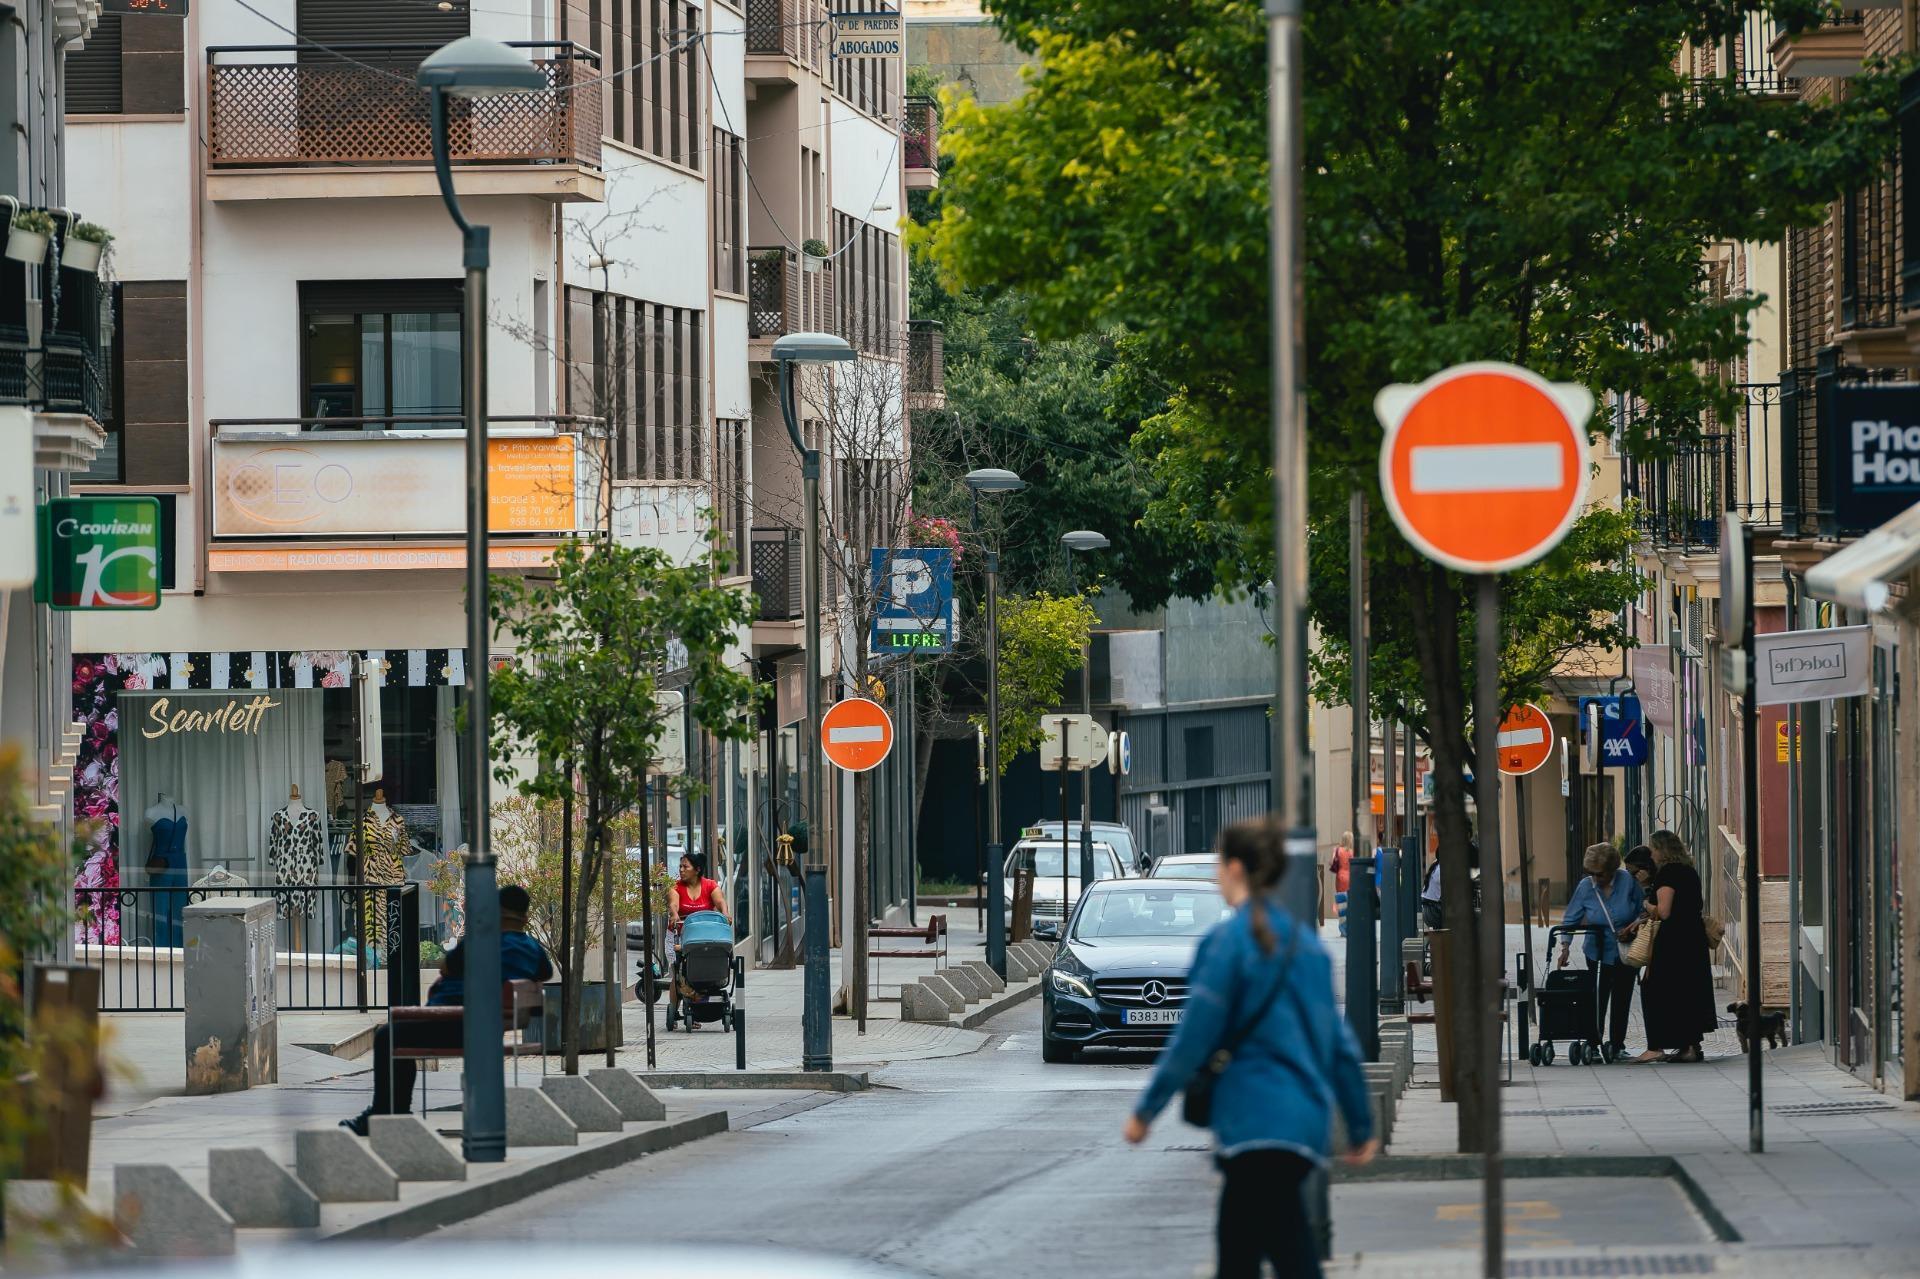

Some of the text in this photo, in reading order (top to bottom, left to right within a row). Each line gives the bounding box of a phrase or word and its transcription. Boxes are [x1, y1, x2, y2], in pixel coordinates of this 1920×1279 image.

[848, 20, 859, 30] DE
[864, 19, 899, 30] PAREDES
[838, 40, 899, 54] ABOGADOS
[229, 463, 353, 504] CEO
[287, 551, 368, 566] RADIOLOGÍA
[892, 558, 932, 610] P
[141, 695, 281, 739] Scarlett
[1603, 738, 1634, 756] AXA
[1130, 1011, 1184, 1022] 6383 HYK
